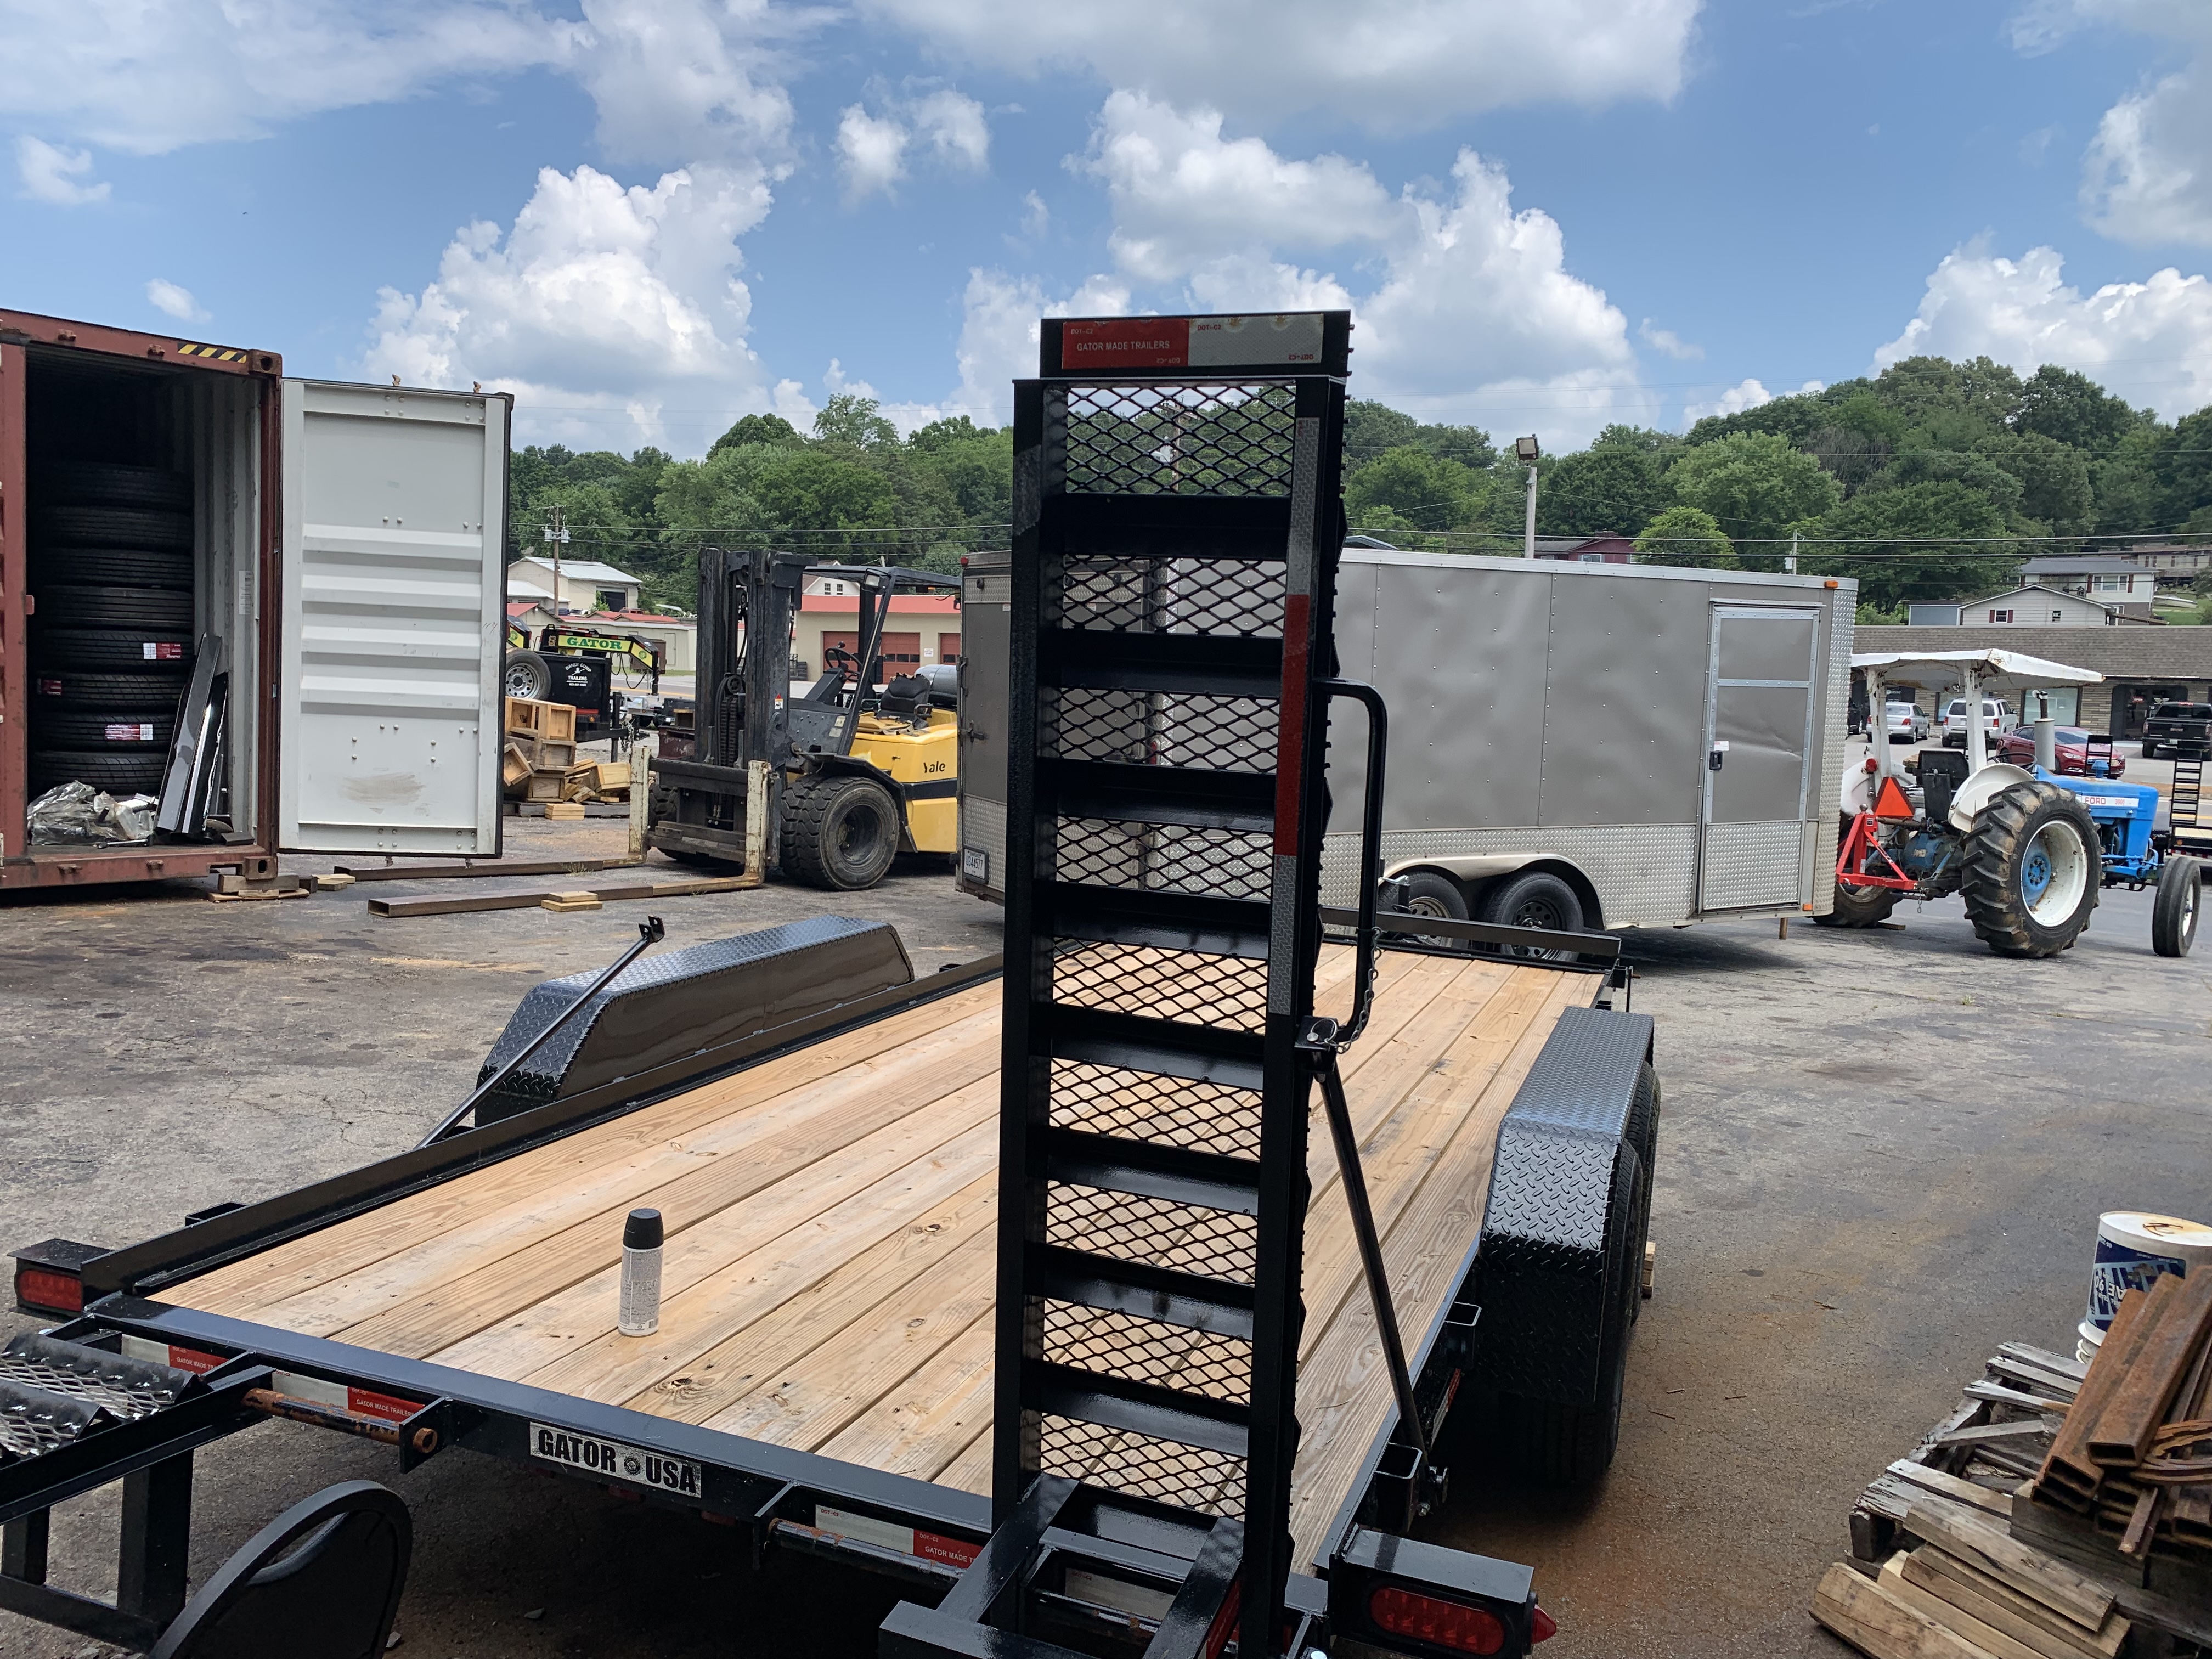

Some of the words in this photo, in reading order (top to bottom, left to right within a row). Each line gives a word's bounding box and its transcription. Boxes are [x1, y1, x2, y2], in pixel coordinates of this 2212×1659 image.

[1077, 342, 1103, 352] GATOR
[1105, 341, 1127, 351] MADE
[1130, 340, 1170, 350] TRAILERS
[567, 637, 622, 650] GATOR
[565, 662, 579, 671] DANDY
[580, 663, 592, 673] DUMP
[923, 760, 946, 774] Yale
[2085, 797, 2106, 805] FORD
[2108, 1282, 2128, 1300] AE
[177, 1356, 193, 1365] GATOR
[193, 1361, 207, 1369] MADE
[356, 1398, 374, 1408] GATOR
[374, 1403, 390, 1413] MADE
[538, 1429, 617, 1473] GATOR
[646, 1455, 697, 1494] USA
[820, 1509, 839, 1517] DOT-C2
[924, 1545, 947, 1557] GATOR
[949, 1552, 968, 1563] MADE
